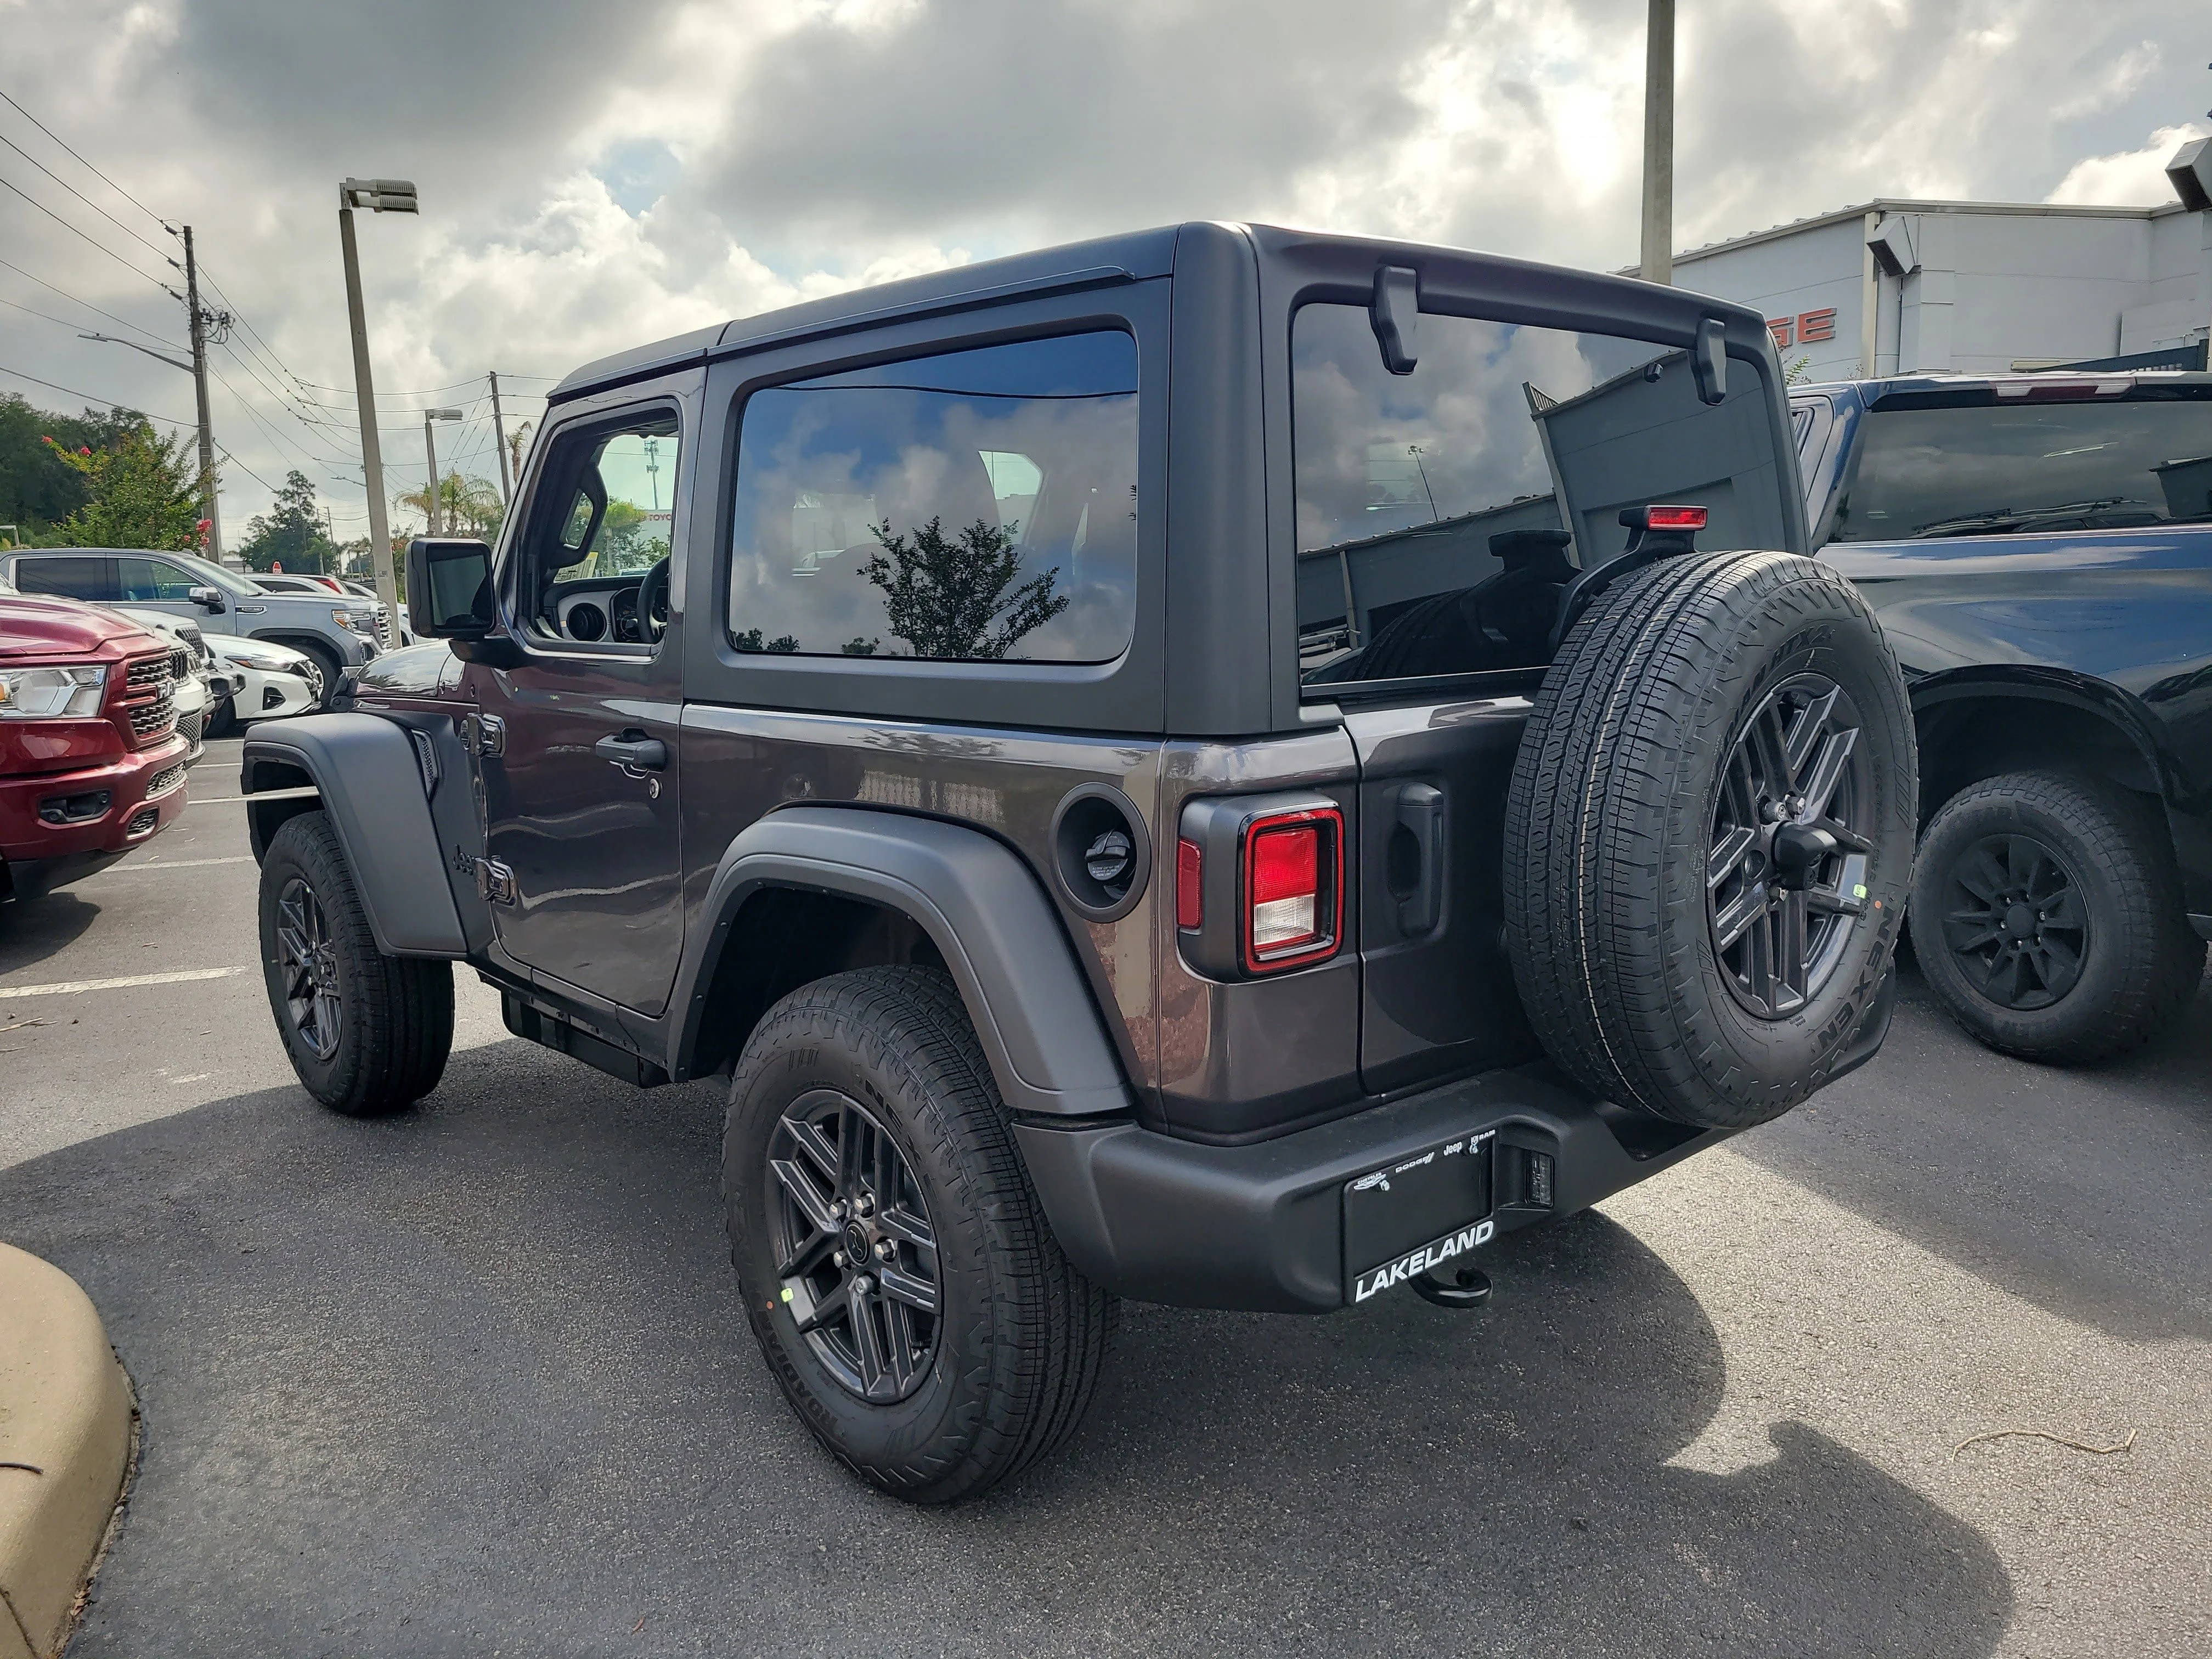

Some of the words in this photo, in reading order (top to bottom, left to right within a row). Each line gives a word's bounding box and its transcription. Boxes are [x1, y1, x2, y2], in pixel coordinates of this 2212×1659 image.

[1817, 905, 1893, 1050] NEXEN
[1357, 1172, 1382, 1184] CHRYSLER
[1443, 1142, 1463, 1156] Jeep
[1479, 1130, 1496, 1141] RAM
[1355, 1220, 1494, 1302] LAKELAND
